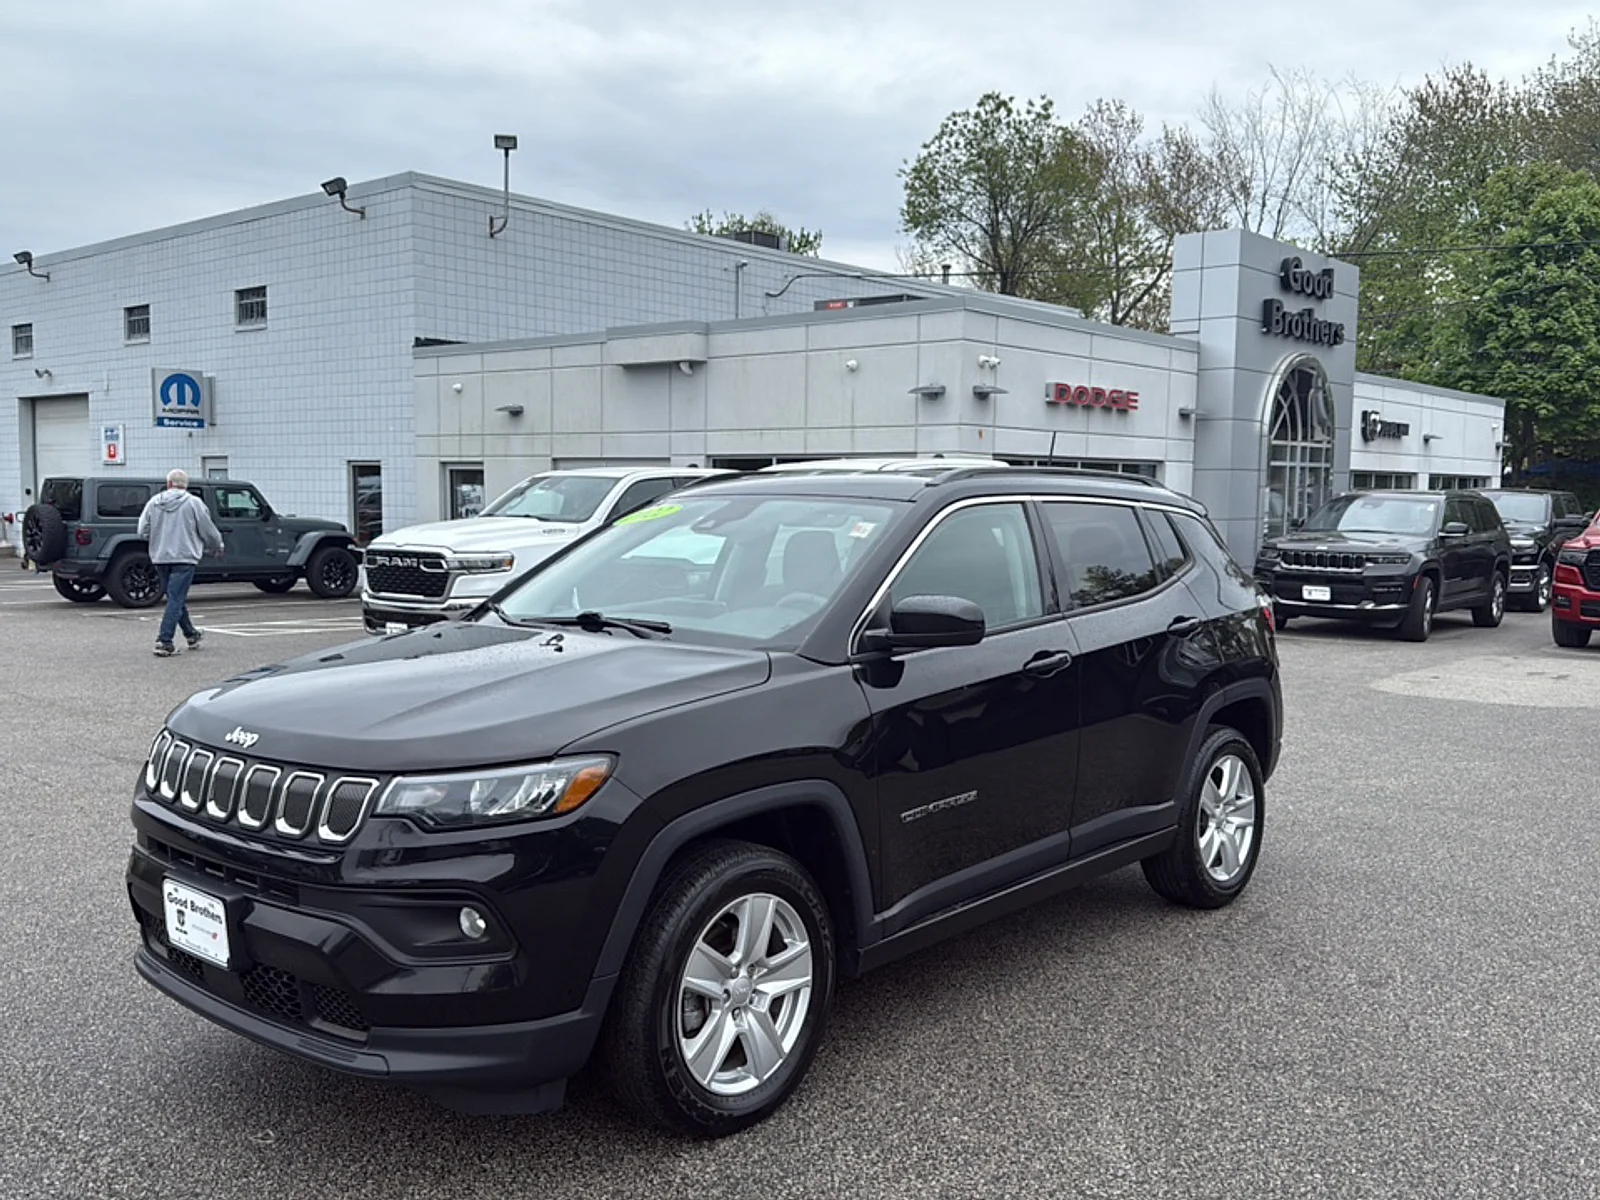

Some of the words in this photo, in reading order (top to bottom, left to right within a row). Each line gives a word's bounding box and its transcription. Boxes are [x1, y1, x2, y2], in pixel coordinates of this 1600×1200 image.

[1281, 256, 1334, 299] Good
[1263, 299, 1345, 346] Brothers
[1047, 382, 1139, 410] DODGE
[163, 418, 199, 427] Service
[378, 556, 417, 567] RAM
[225, 726, 259, 748] Jeep
[167, 891, 188, 909] Good
[190, 900, 223, 925] Brothers
